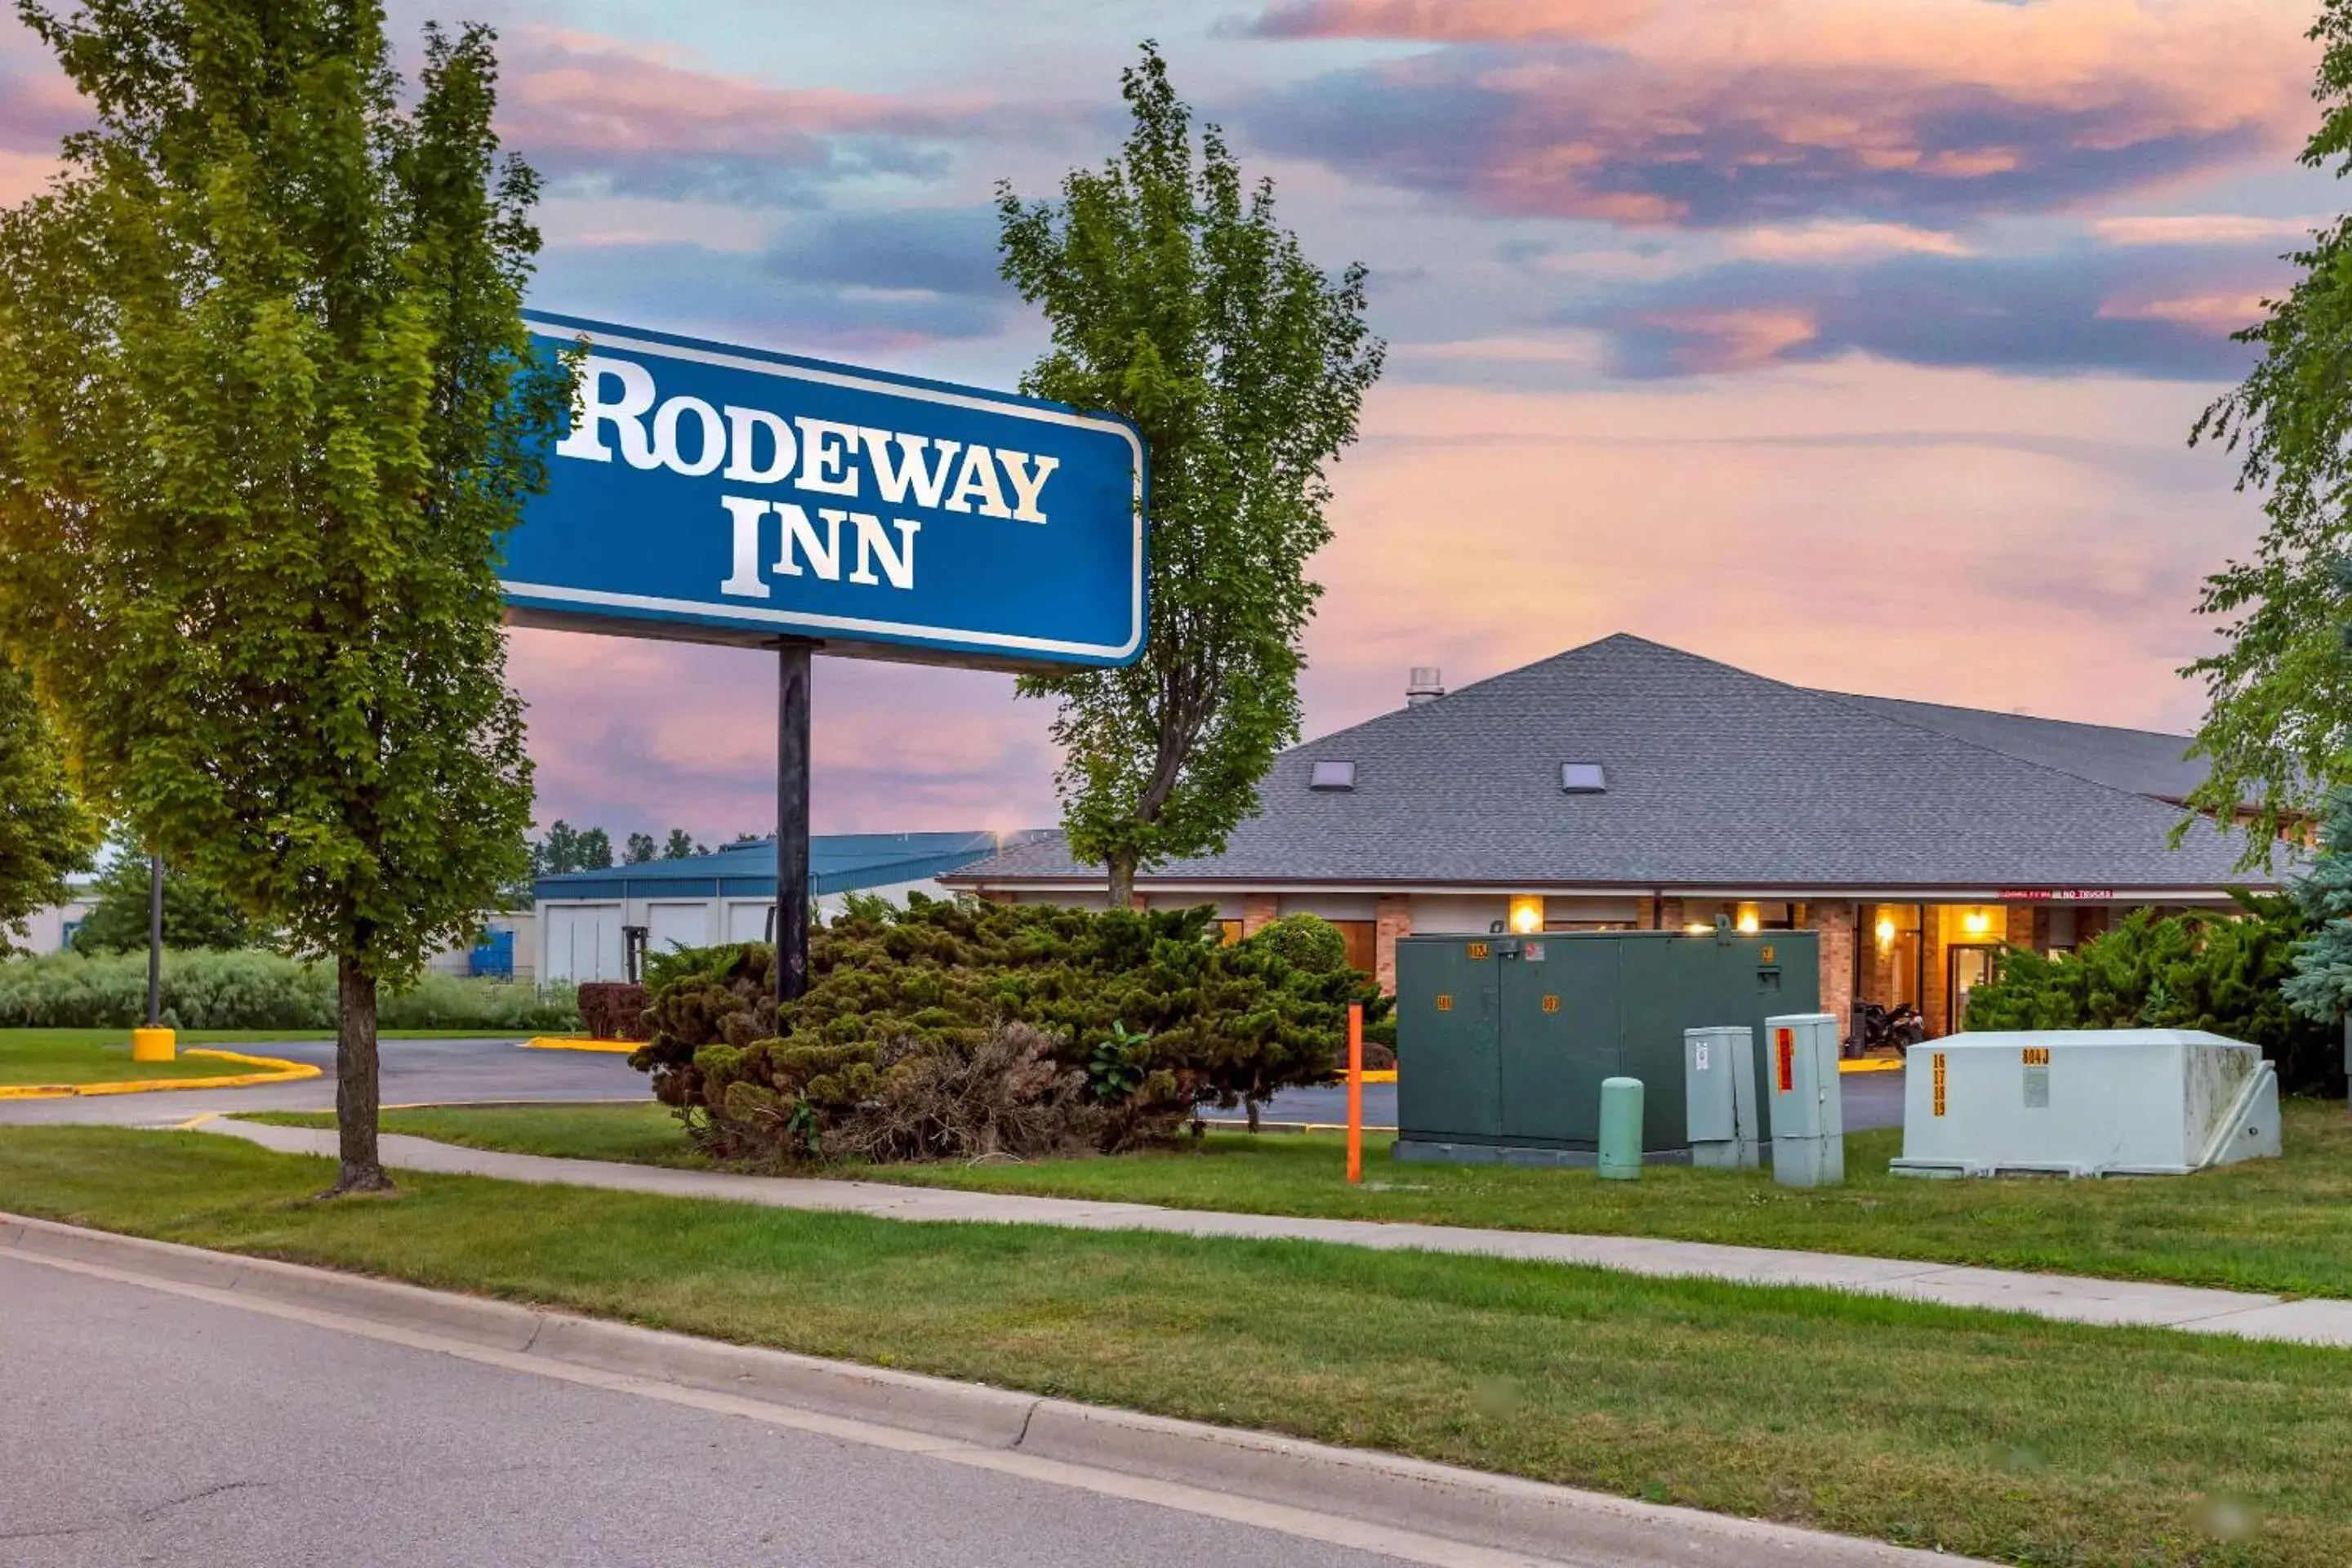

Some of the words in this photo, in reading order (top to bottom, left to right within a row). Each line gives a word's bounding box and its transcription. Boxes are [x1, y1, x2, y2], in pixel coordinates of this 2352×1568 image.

[556, 350, 1059, 523] RODEWAY
[721, 495, 921, 598] INN
[1933, 1054, 1945, 1068] 16
[2022, 1048, 2049, 1065] 804J
[1934, 1070, 1944, 1085] 17
